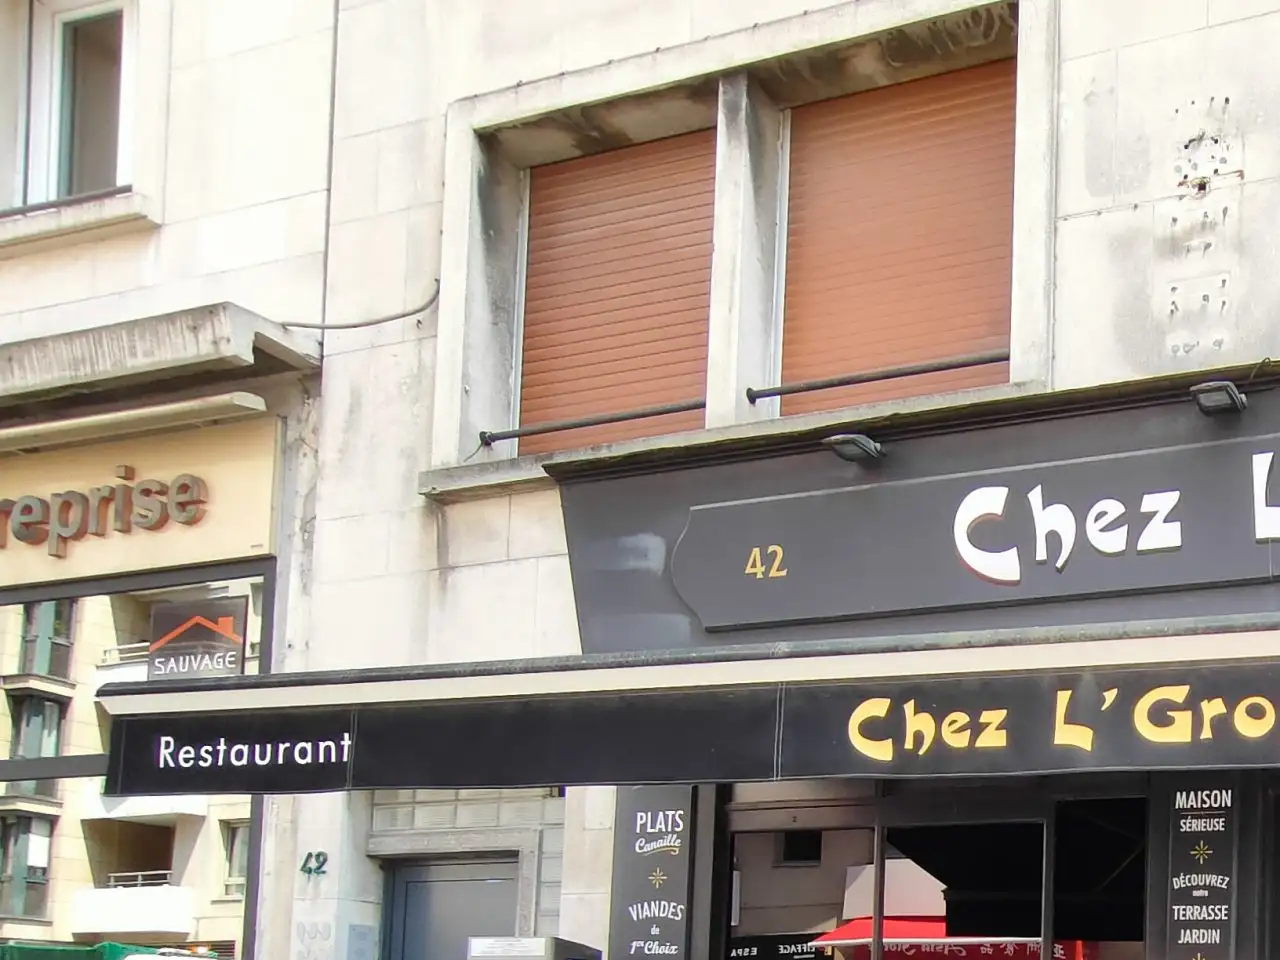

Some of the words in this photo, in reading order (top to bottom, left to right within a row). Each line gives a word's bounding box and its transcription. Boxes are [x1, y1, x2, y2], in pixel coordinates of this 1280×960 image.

[744, 544, 788, 580] 42
[953, 483, 1183, 586] Chez
[153, 651, 237, 675] SAUVAGE
[848, 697, 1007, 762] Chez
[158, 733, 352, 769] Restaurant
[1175, 790, 1232, 809] MAISON
[636, 810, 684, 834] PLATS
[1180, 817, 1226, 832] SÉRIEUSE
[635, 835, 682, 854] Canaille
[300, 851, 328, 876] 42
[1173, 873, 1230, 890] DÉCOUVREZ
[629, 900, 685, 921] VIANDES
[1173, 905, 1229, 921] TERRASSE
[650, 924, 660, 935] de
[1178, 928, 1221, 944] JARDIN
[644, 940, 679, 955] Choix
